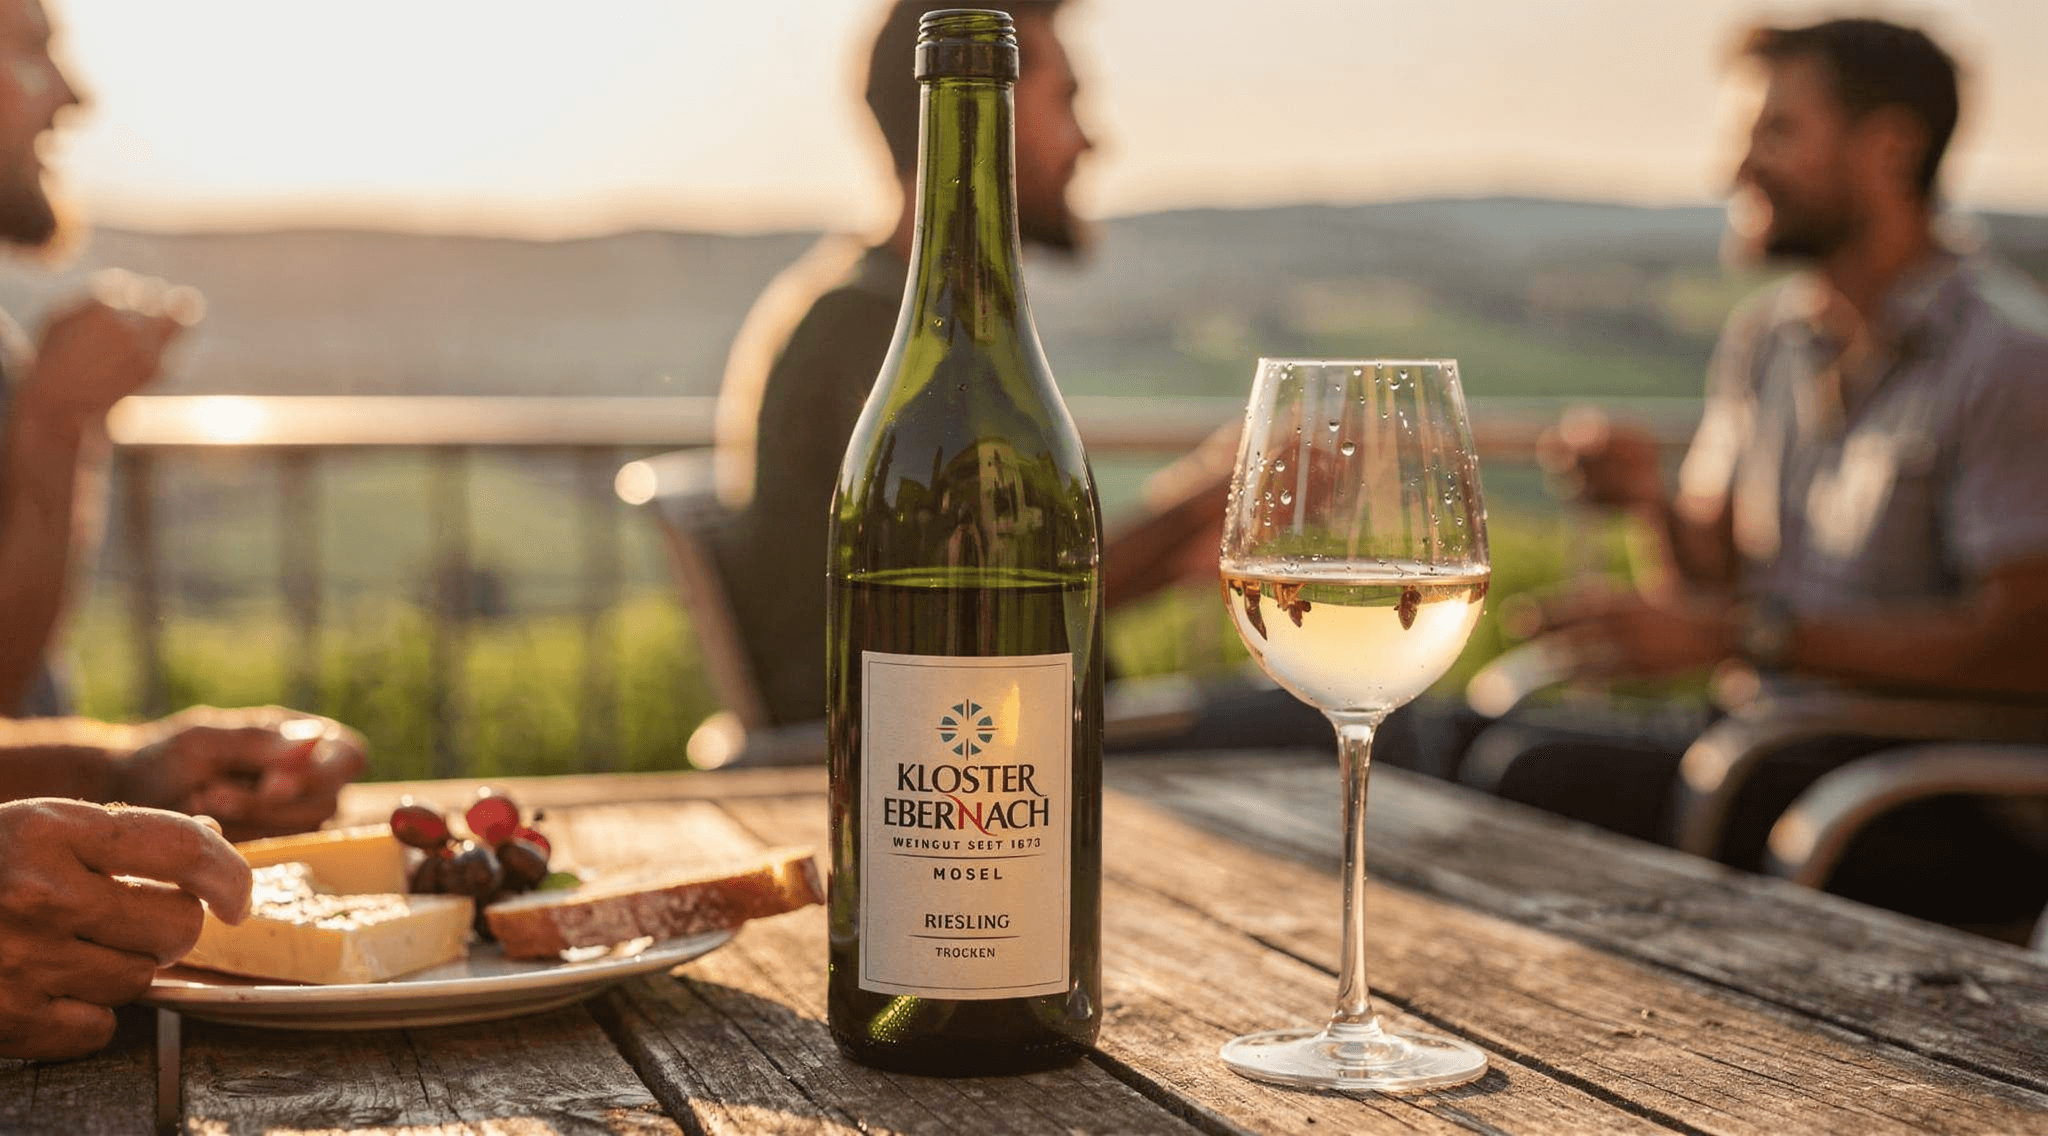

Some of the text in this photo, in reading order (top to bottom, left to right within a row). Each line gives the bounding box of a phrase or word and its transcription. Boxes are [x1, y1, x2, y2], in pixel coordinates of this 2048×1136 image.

[897, 762, 1048, 797] KLOSTER
[884, 794, 1049, 837] EBERNACH
[893, 837, 960, 850] WEINGUT
[933, 867, 1003, 880] MOSEL
[925, 913, 1010, 930] RIESLING
[936, 947, 996, 959] TROCKEN
